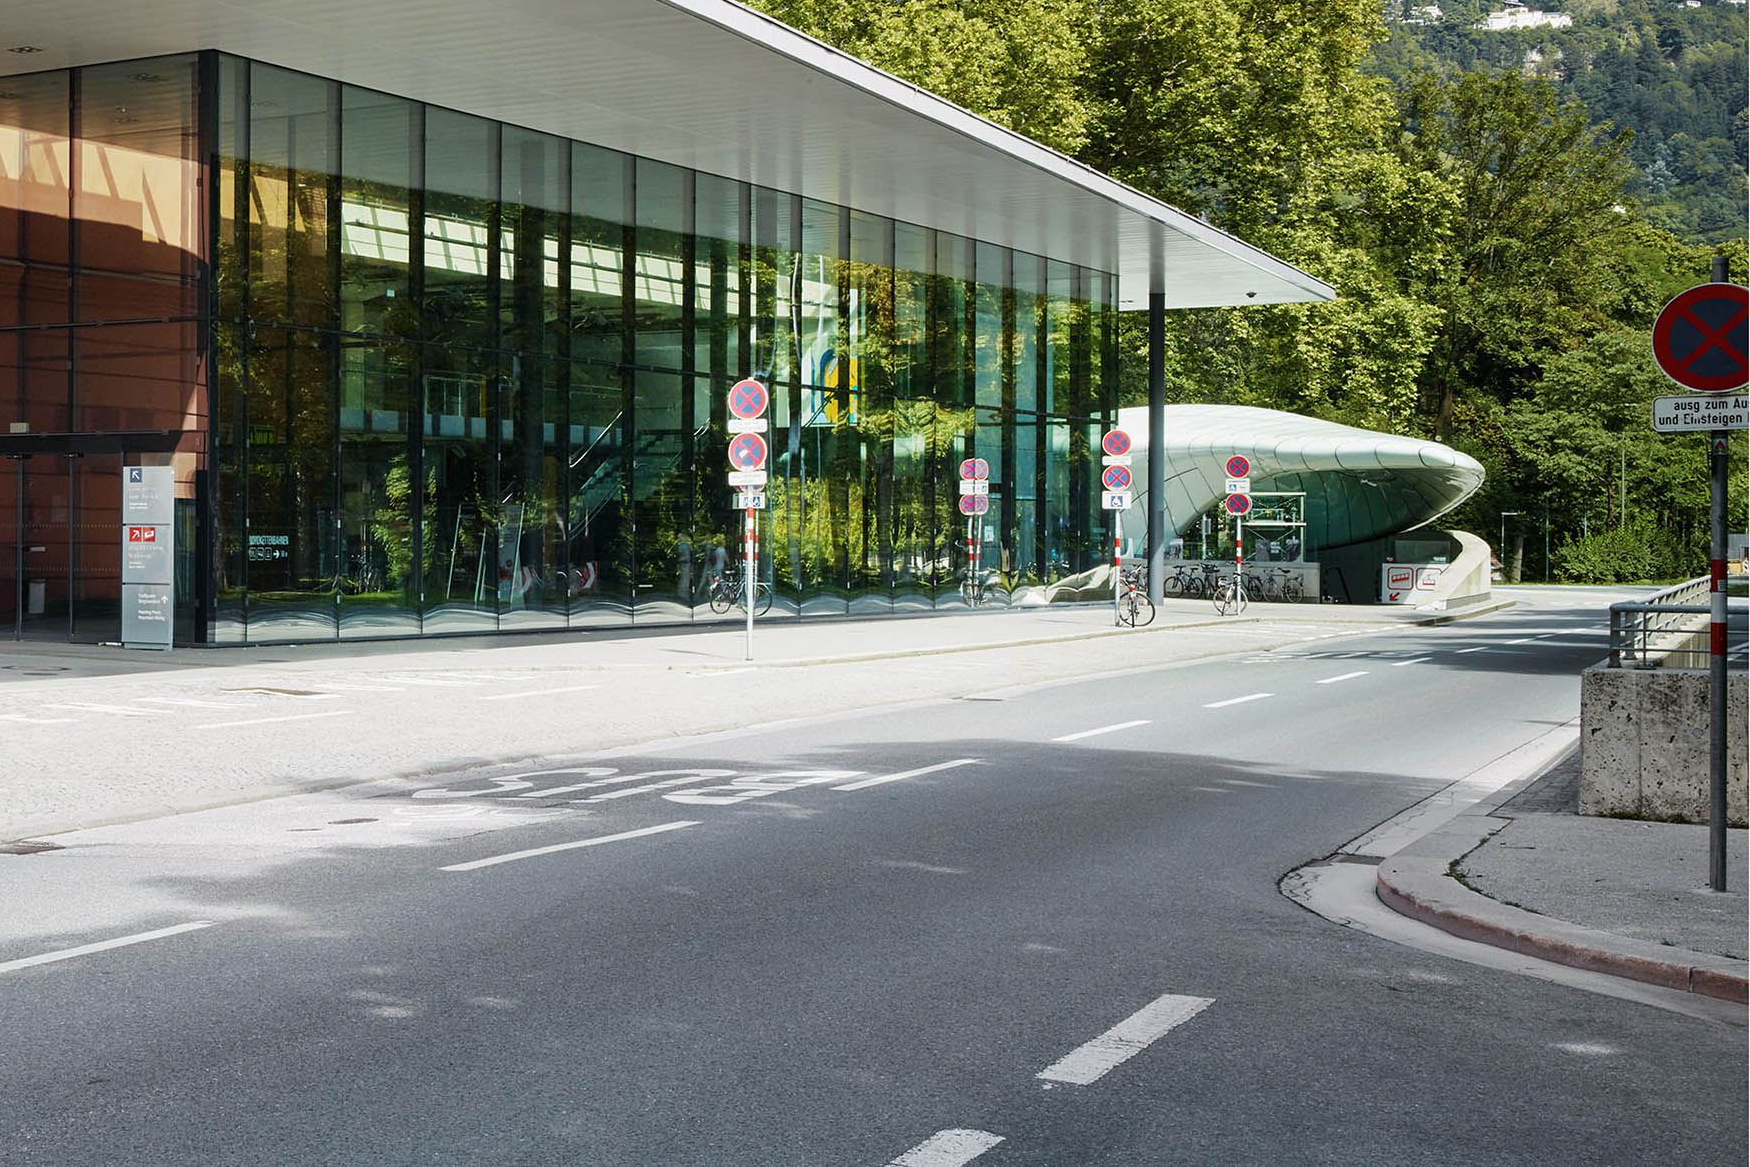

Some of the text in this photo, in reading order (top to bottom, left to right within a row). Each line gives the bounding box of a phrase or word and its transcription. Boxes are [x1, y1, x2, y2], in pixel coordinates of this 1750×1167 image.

[1674, 397, 1748, 413] ausg zum Au
[1659, 414, 1678, 426] und
[412, 766, 867, 806] BUS
